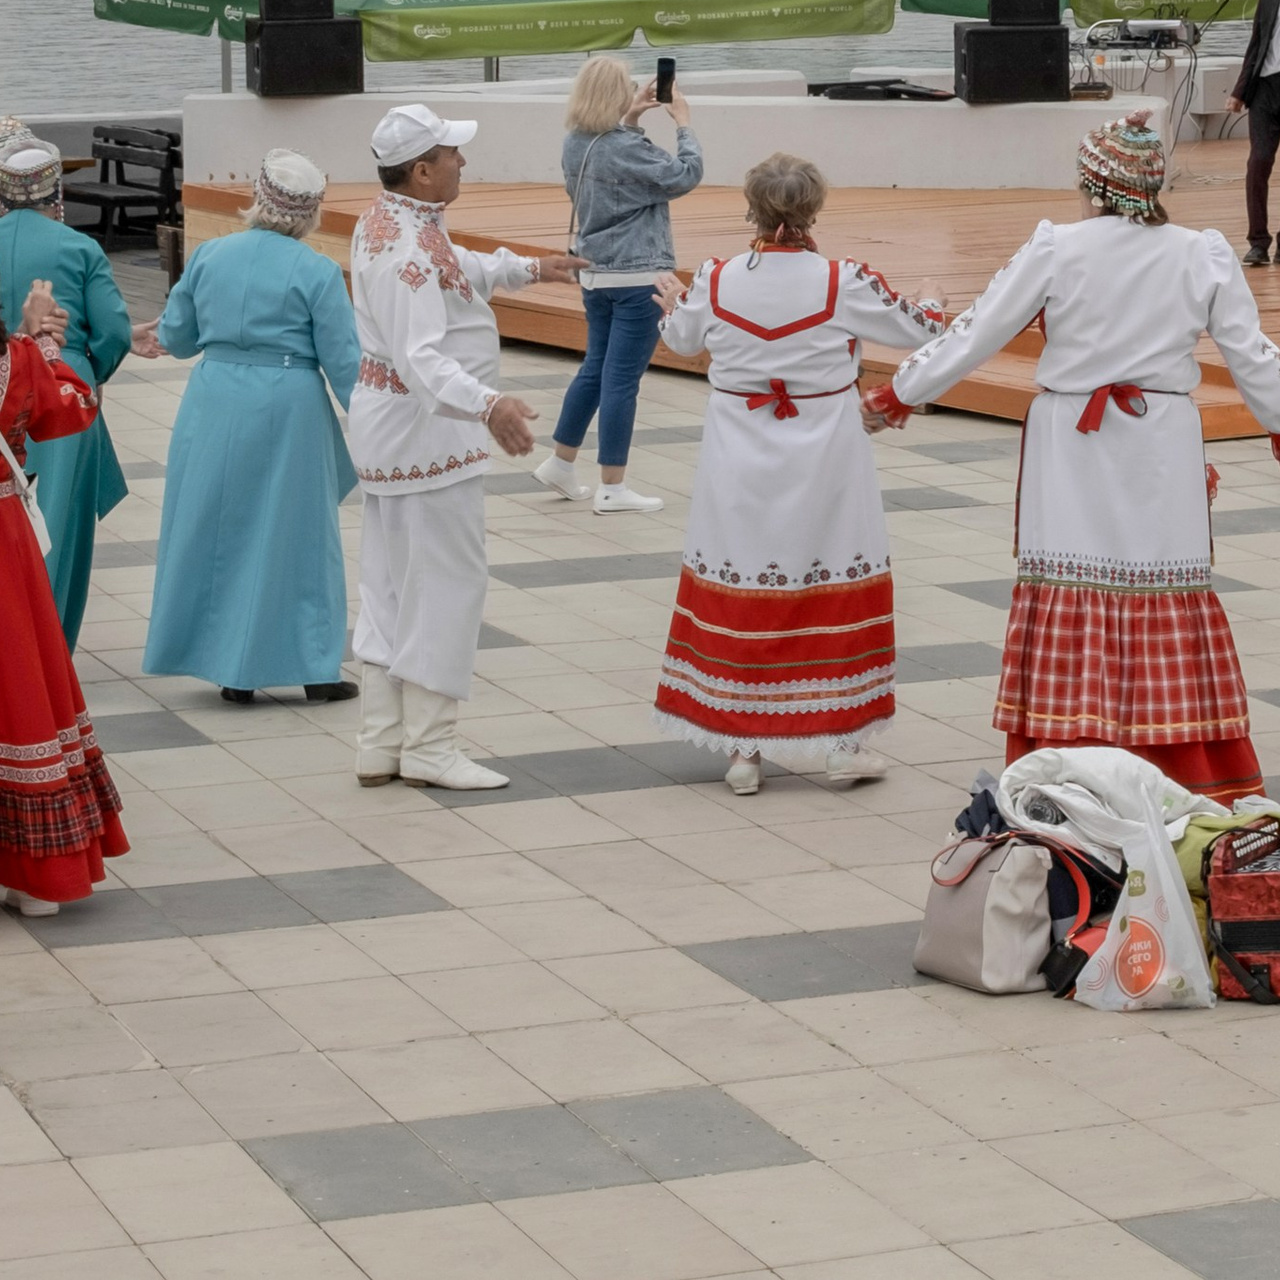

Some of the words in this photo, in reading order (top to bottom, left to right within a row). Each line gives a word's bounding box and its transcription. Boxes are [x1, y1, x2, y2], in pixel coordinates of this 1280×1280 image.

[655, 9, 691, 26] Carlsberg
[697, 11, 734, 20] PROBABLY
[736, 10, 749, 18] THE
[804, 6, 812, 14] IN
[814, 5, 827, 13] THE
[829, 4, 853, 13] WORLD
[413, 22, 451, 40] Carlsberg
[459, 24, 497, 33] PROBABLY
[500, 23, 514, 31] THE
[516, 22, 534, 30] BEST
[550, 20, 568, 28] BEER
[571, 19, 579, 27] IN
[598, 17, 624, 26] WORLD
